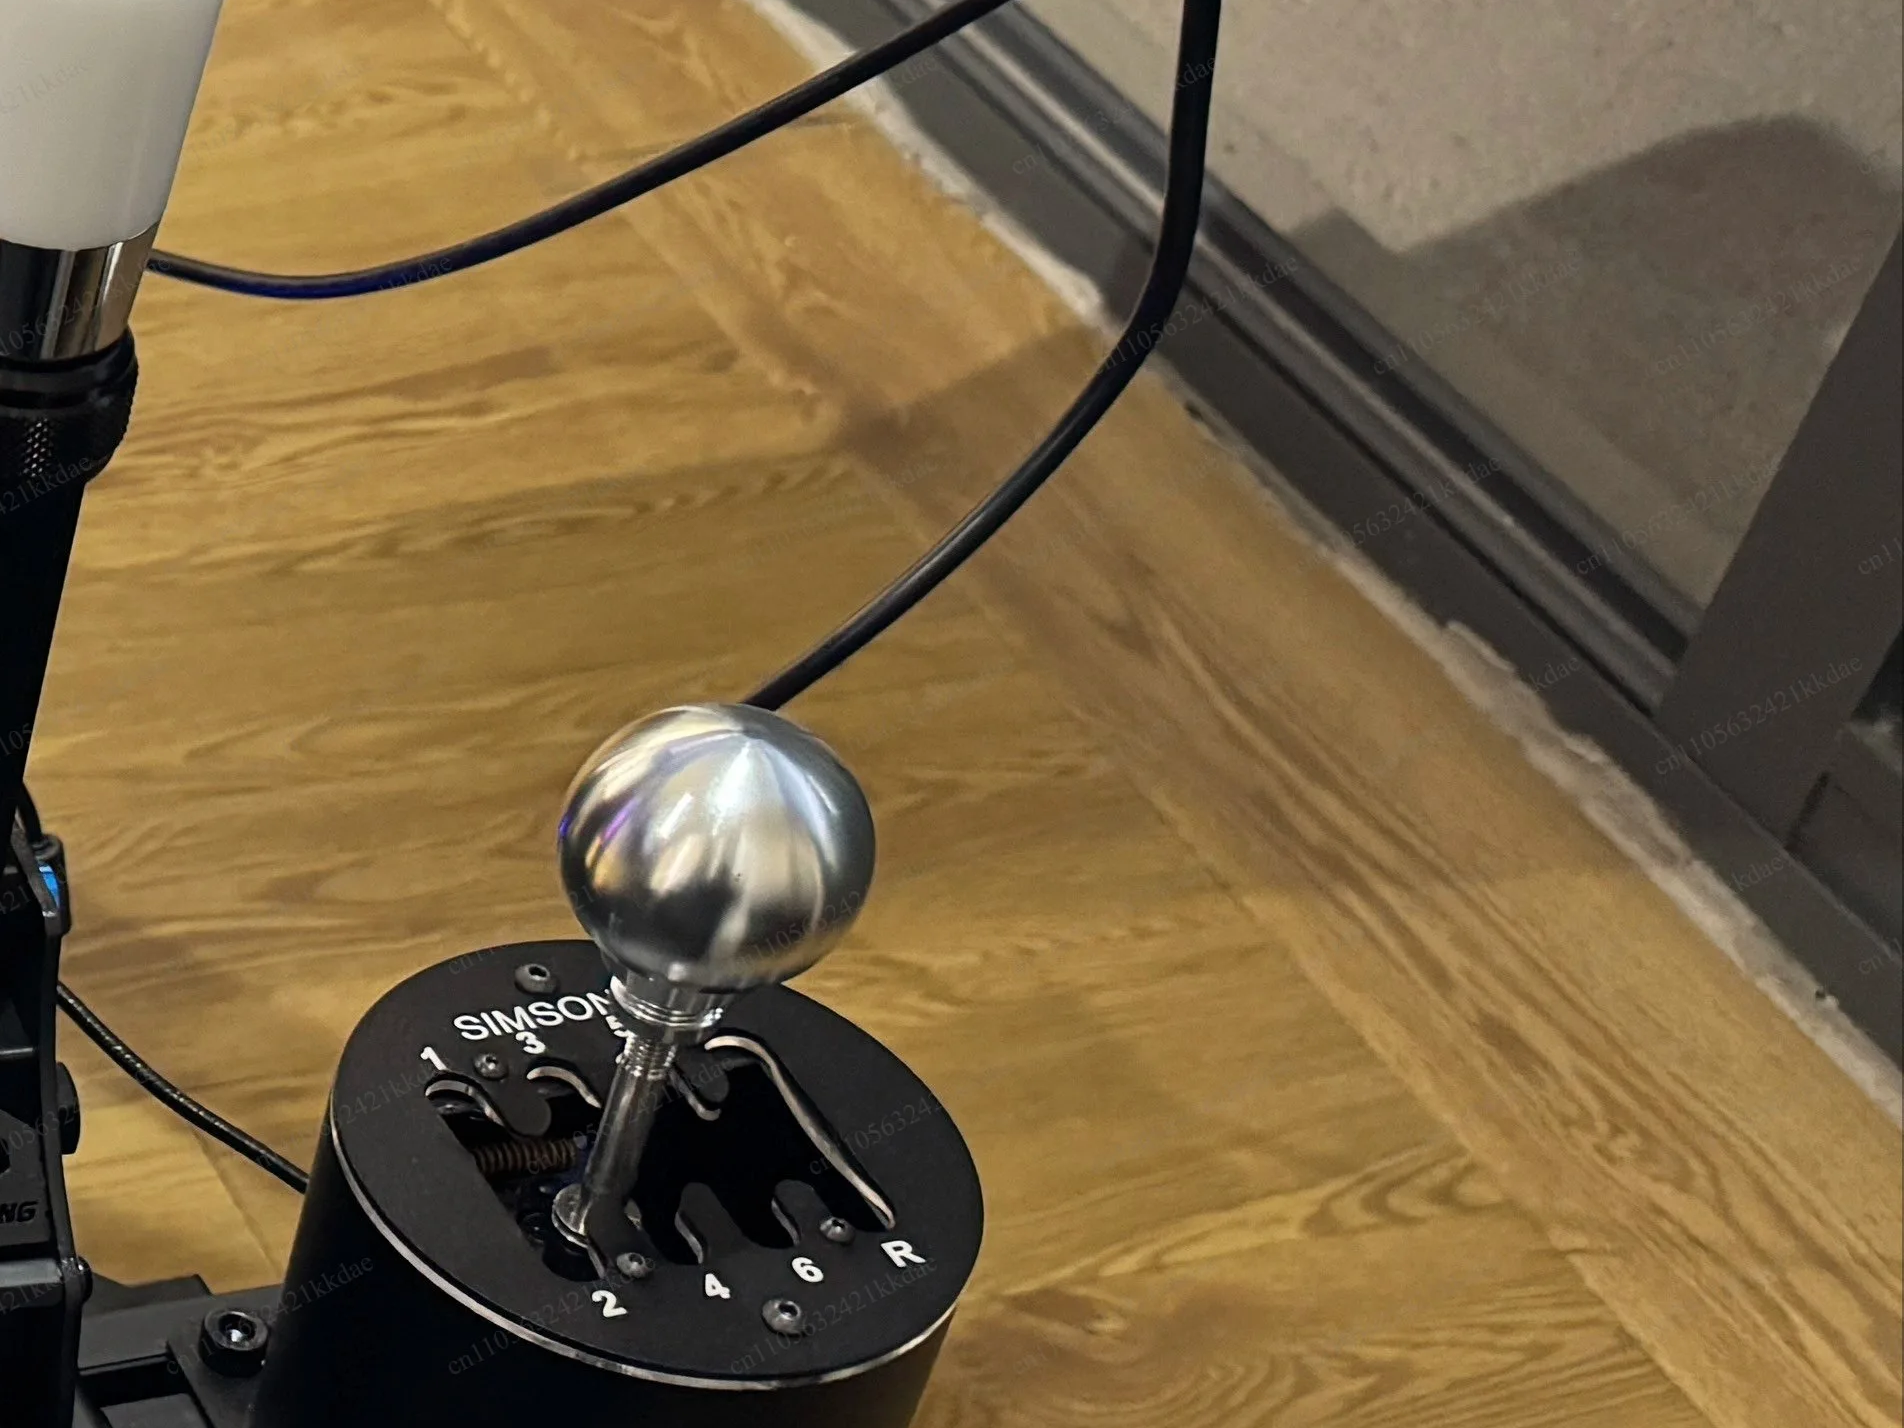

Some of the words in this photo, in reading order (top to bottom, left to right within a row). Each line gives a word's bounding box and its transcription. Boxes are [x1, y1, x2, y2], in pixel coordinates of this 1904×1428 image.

[453, 988, 611, 1041] SIMSON
[420, 1045, 449, 1071] 1
[515, 1030, 546, 1055] 3
[591, 1289, 629, 1319] 2
[704, 1272, 731, 1300] 4
[791, 1256, 825, 1283] 6
[880, 1239, 927, 1268] R
